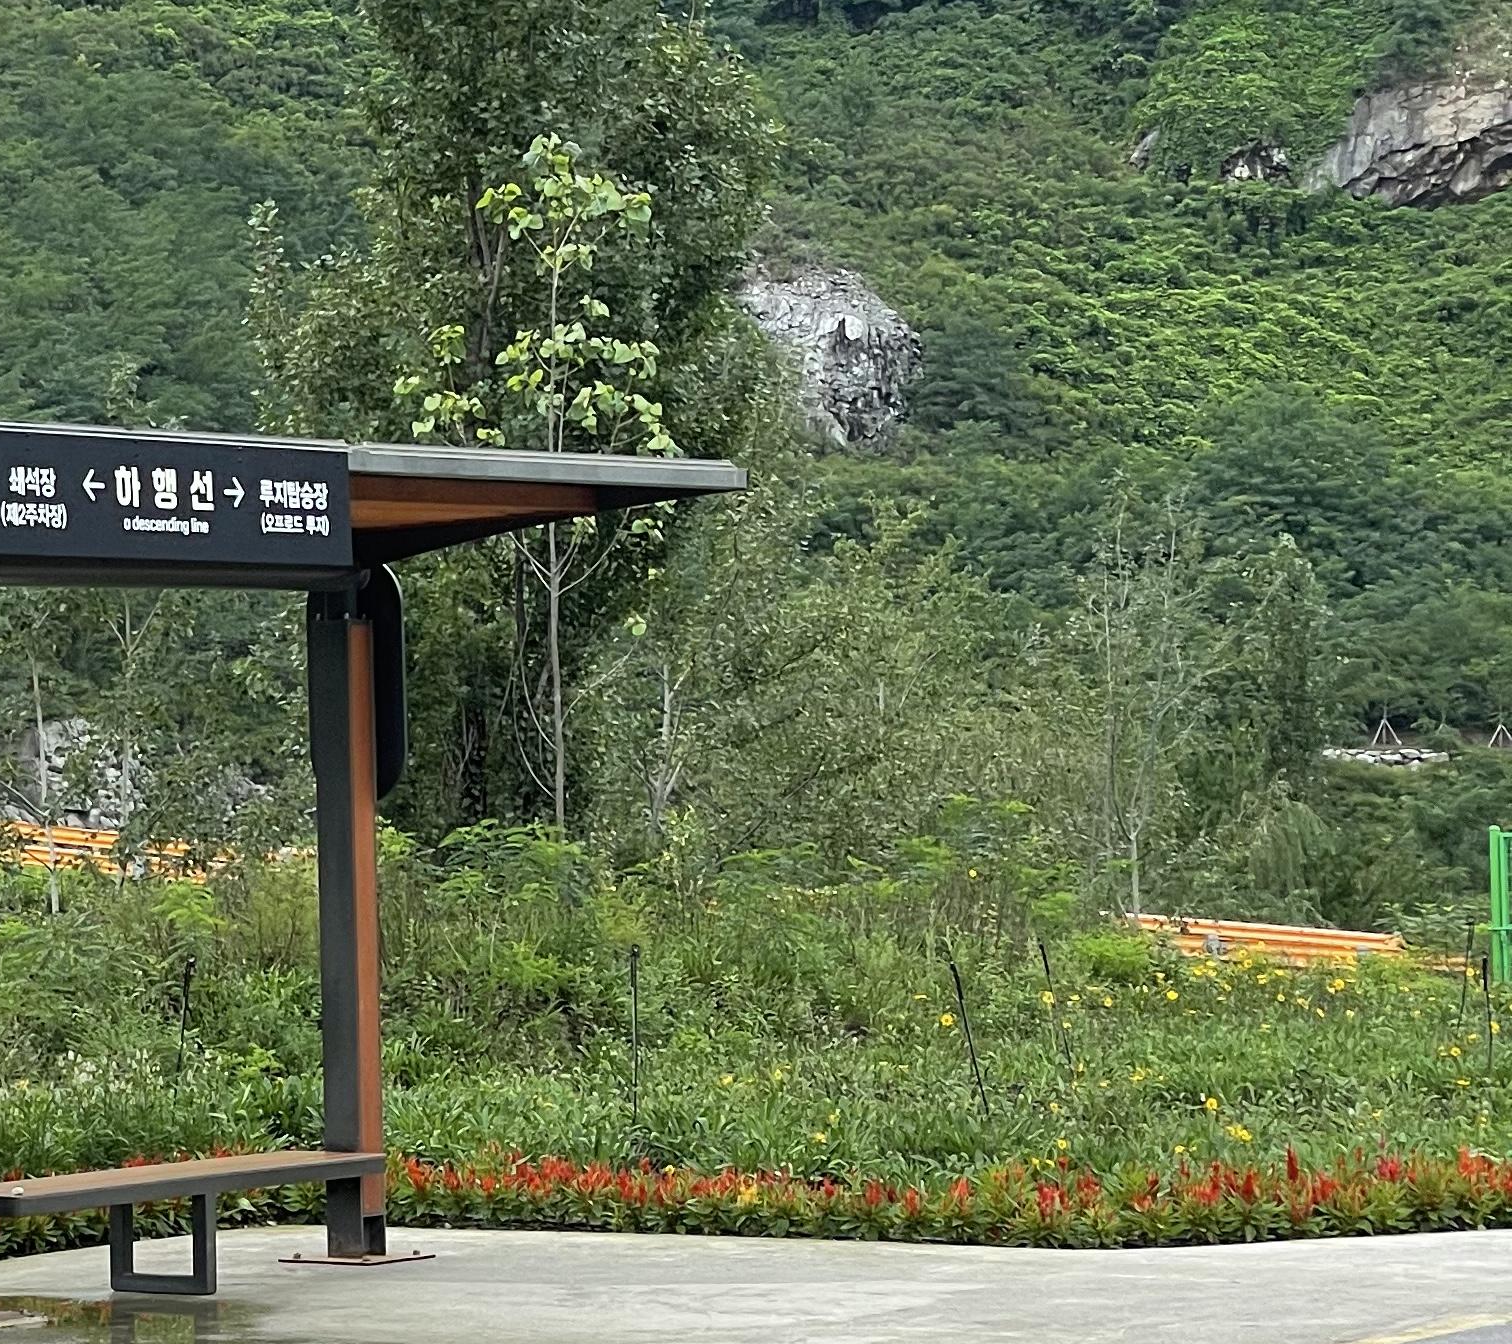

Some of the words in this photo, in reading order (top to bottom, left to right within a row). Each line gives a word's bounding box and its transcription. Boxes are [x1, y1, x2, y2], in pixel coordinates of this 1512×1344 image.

[8, 466, 57, 498] 쇄석장
[259, 479, 329, 511] 루지탑승장
[0, 500, 68, 530] (제2주차장)
[131, 515, 190, 536] descending
[190, 517, 210, 534] line
